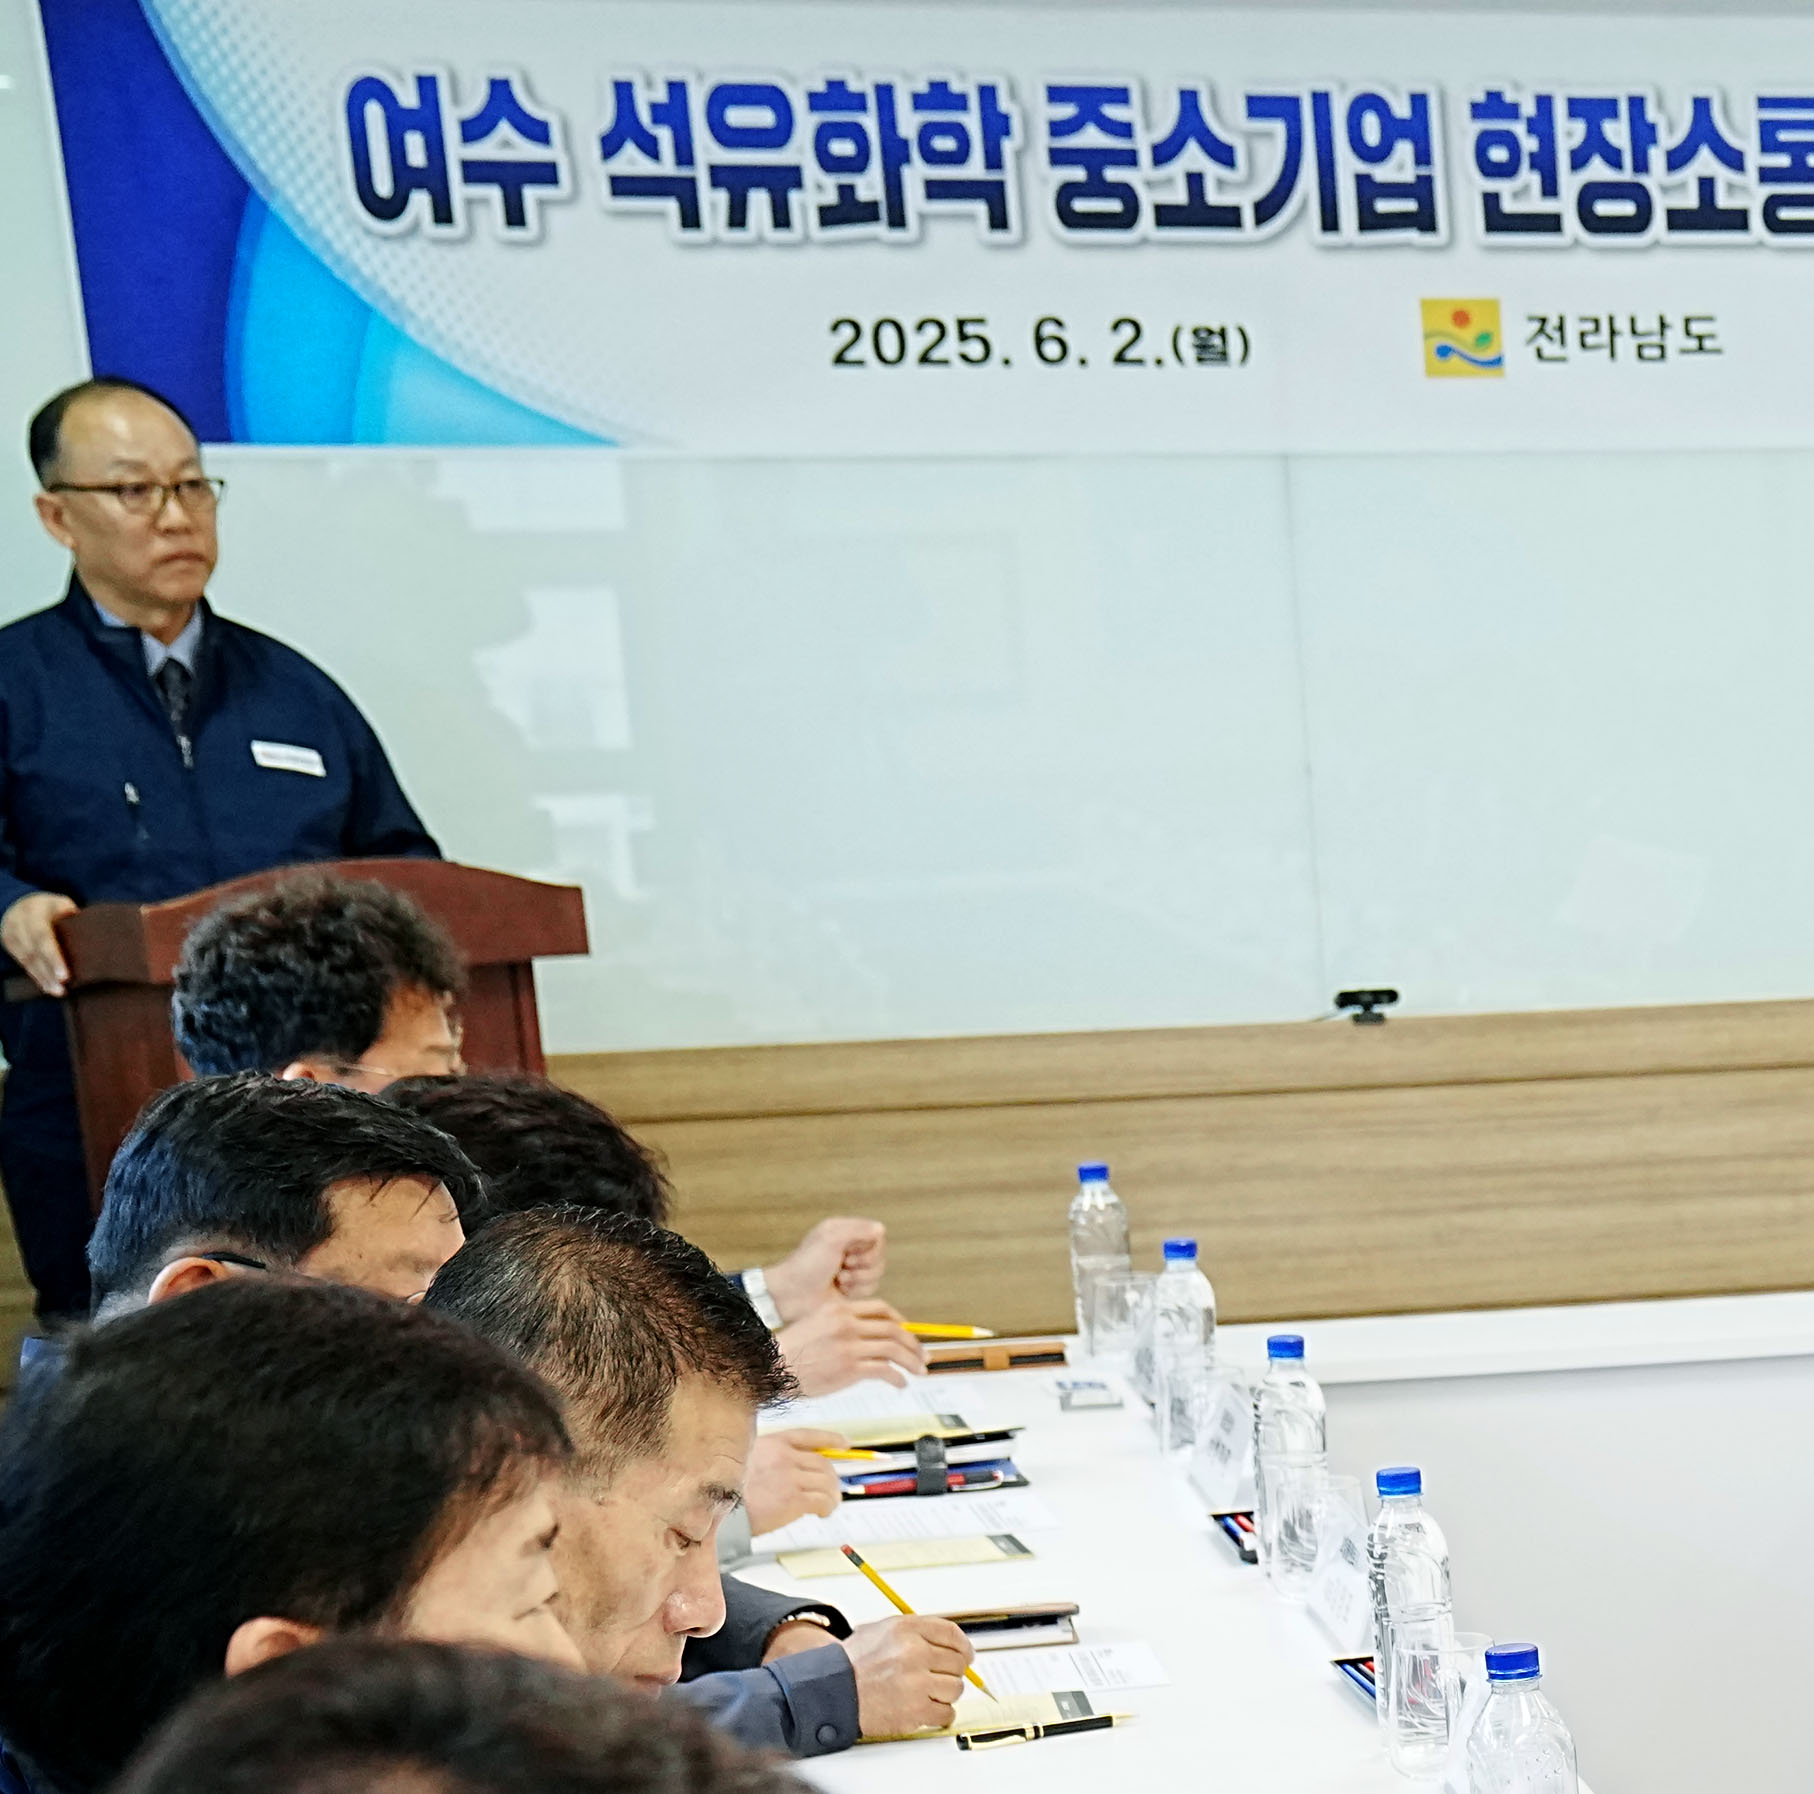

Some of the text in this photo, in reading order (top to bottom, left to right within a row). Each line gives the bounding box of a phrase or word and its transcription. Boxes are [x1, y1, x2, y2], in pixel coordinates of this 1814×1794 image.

[345, 74, 560, 230] 여수
[600, 78, 1010, 231] 석유화학
[1045, 84, 1438, 234] 중소기업
[830, 316, 1011, 368] 2025.
[1032, 316, 1089, 367] 6.
[1524, 314, 1724, 363] 전라남도
